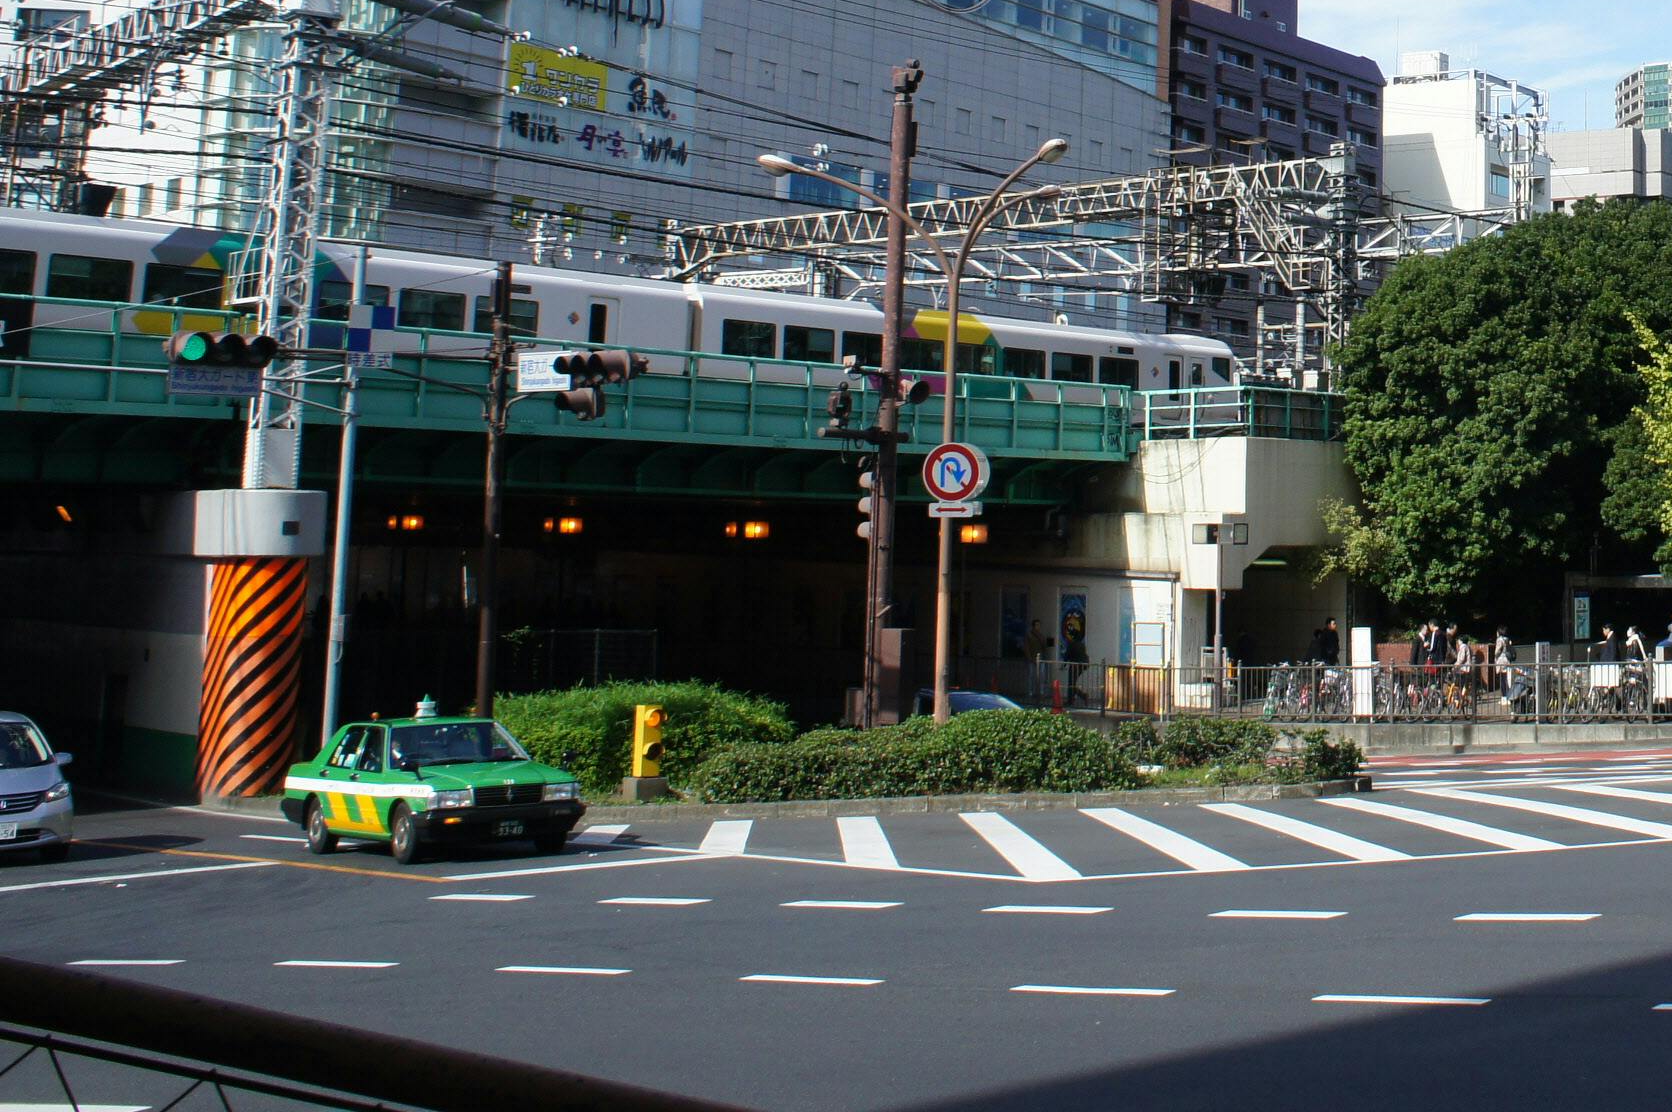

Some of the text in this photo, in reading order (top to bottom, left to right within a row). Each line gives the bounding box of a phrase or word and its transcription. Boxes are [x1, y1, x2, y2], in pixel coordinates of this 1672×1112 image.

[545, 68, 600, 93] ワンカラ
[628, 77, 671, 119] 魚民
[348, 353, 392, 368] 時差式
